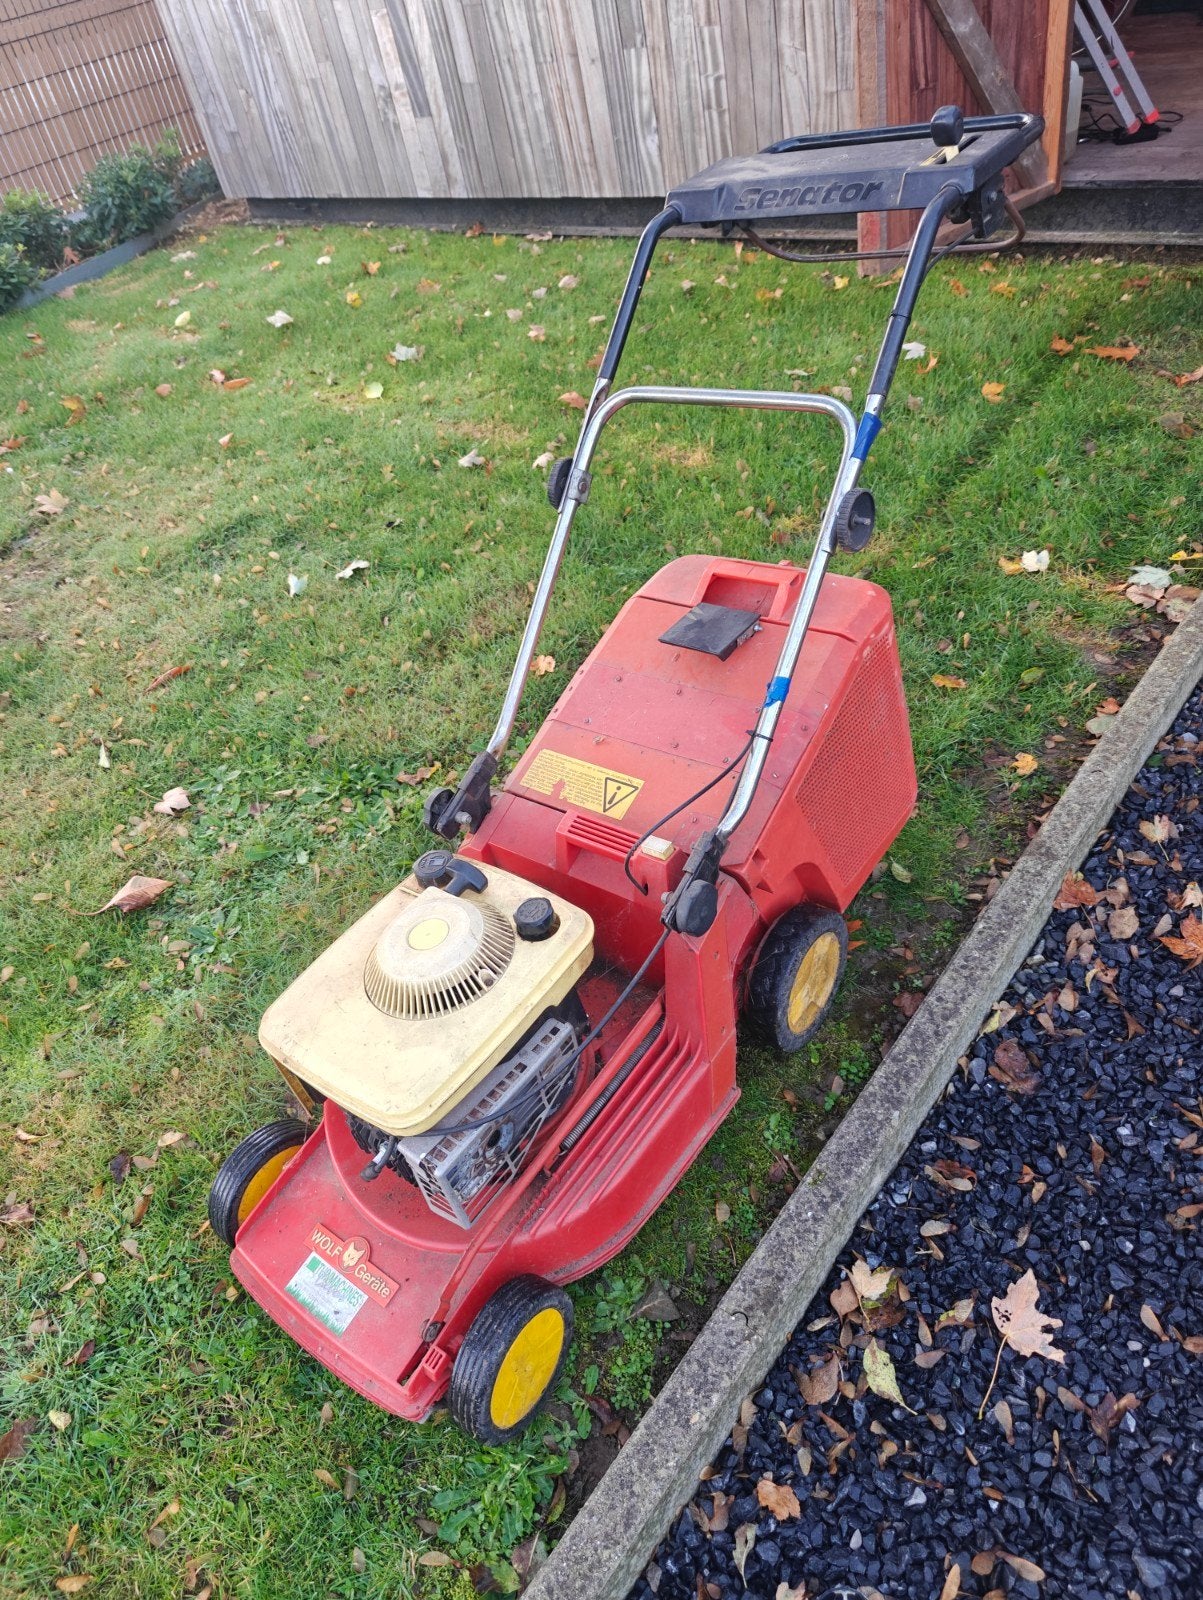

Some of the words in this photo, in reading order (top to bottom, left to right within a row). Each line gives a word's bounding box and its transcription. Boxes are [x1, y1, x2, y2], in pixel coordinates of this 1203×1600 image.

[734, 180, 884, 211] Senator
[310, 1228, 343, 1258] WOLF
[354, 1263, 391, 1299] Geräte
[315, 1262, 363, 1308] TMACHINES
